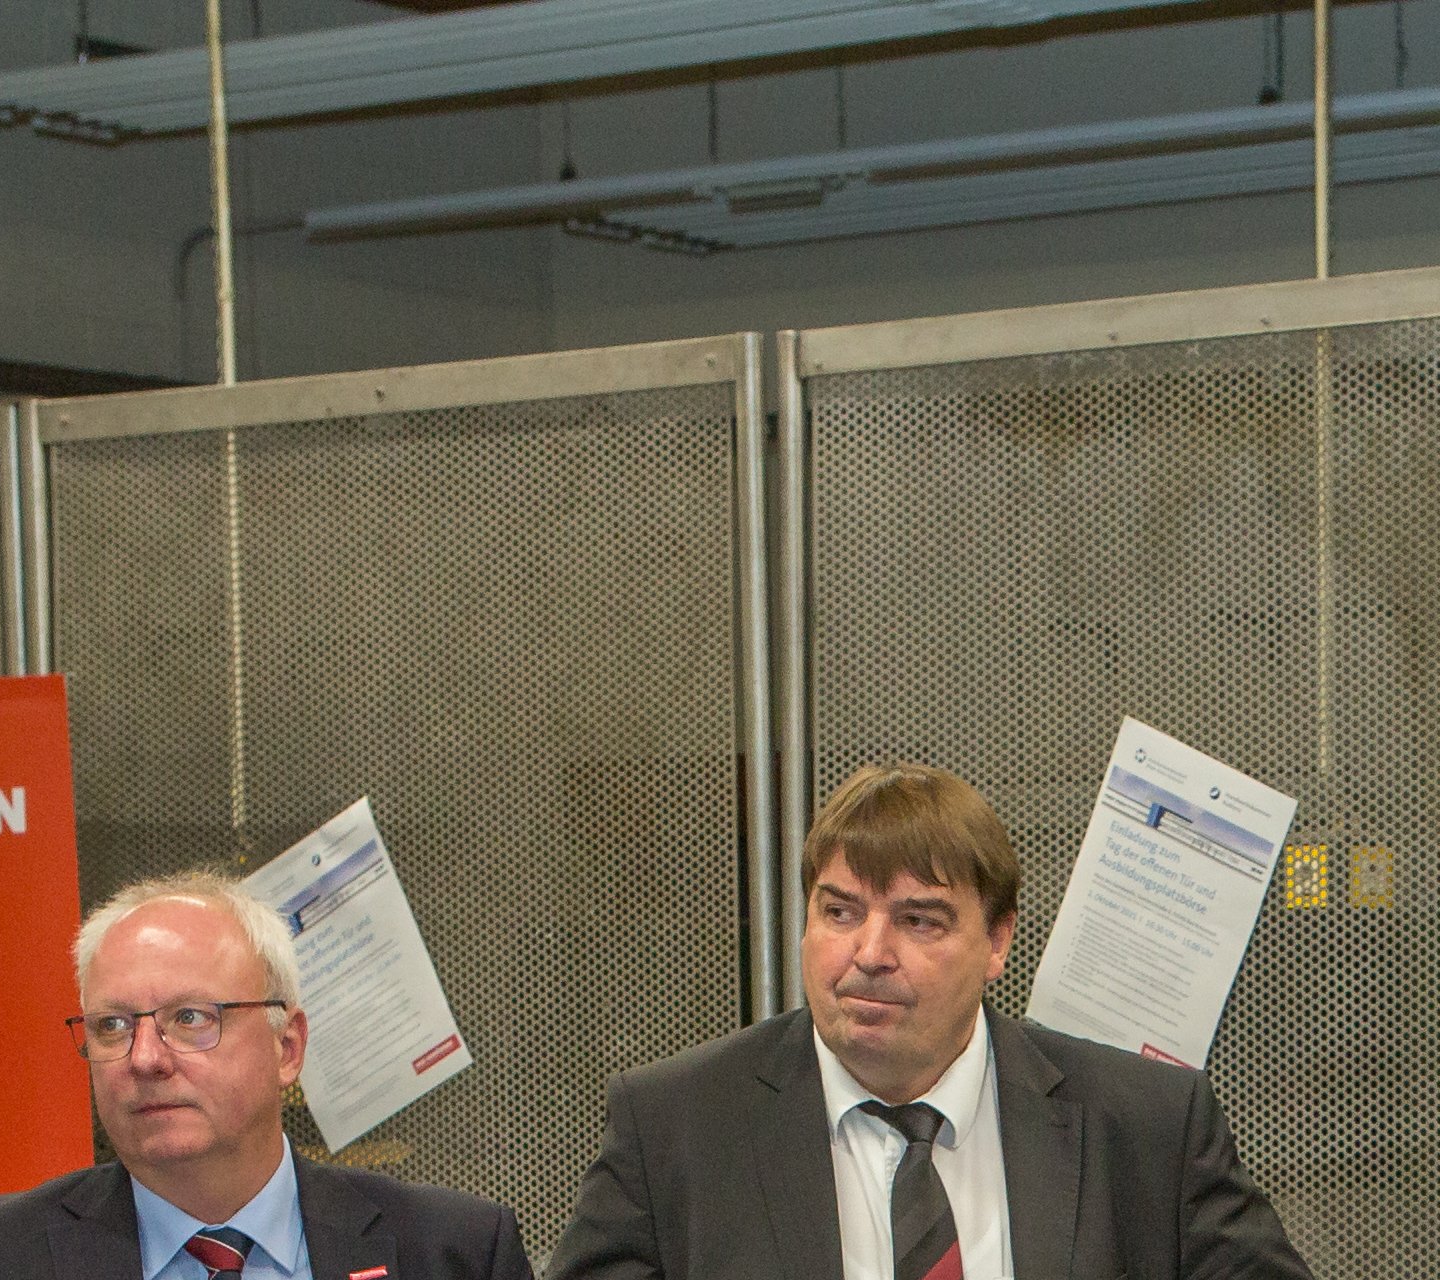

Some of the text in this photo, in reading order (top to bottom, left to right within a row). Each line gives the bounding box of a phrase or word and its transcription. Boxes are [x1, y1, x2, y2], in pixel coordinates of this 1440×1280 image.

[1104, 836, 1122, 856] Tag
[1122, 846, 1139, 861] der
[1178, 872, 1196, 889] Tür
[1194, 883, 1216, 900] und
[1158, 846, 1182, 864] zum
